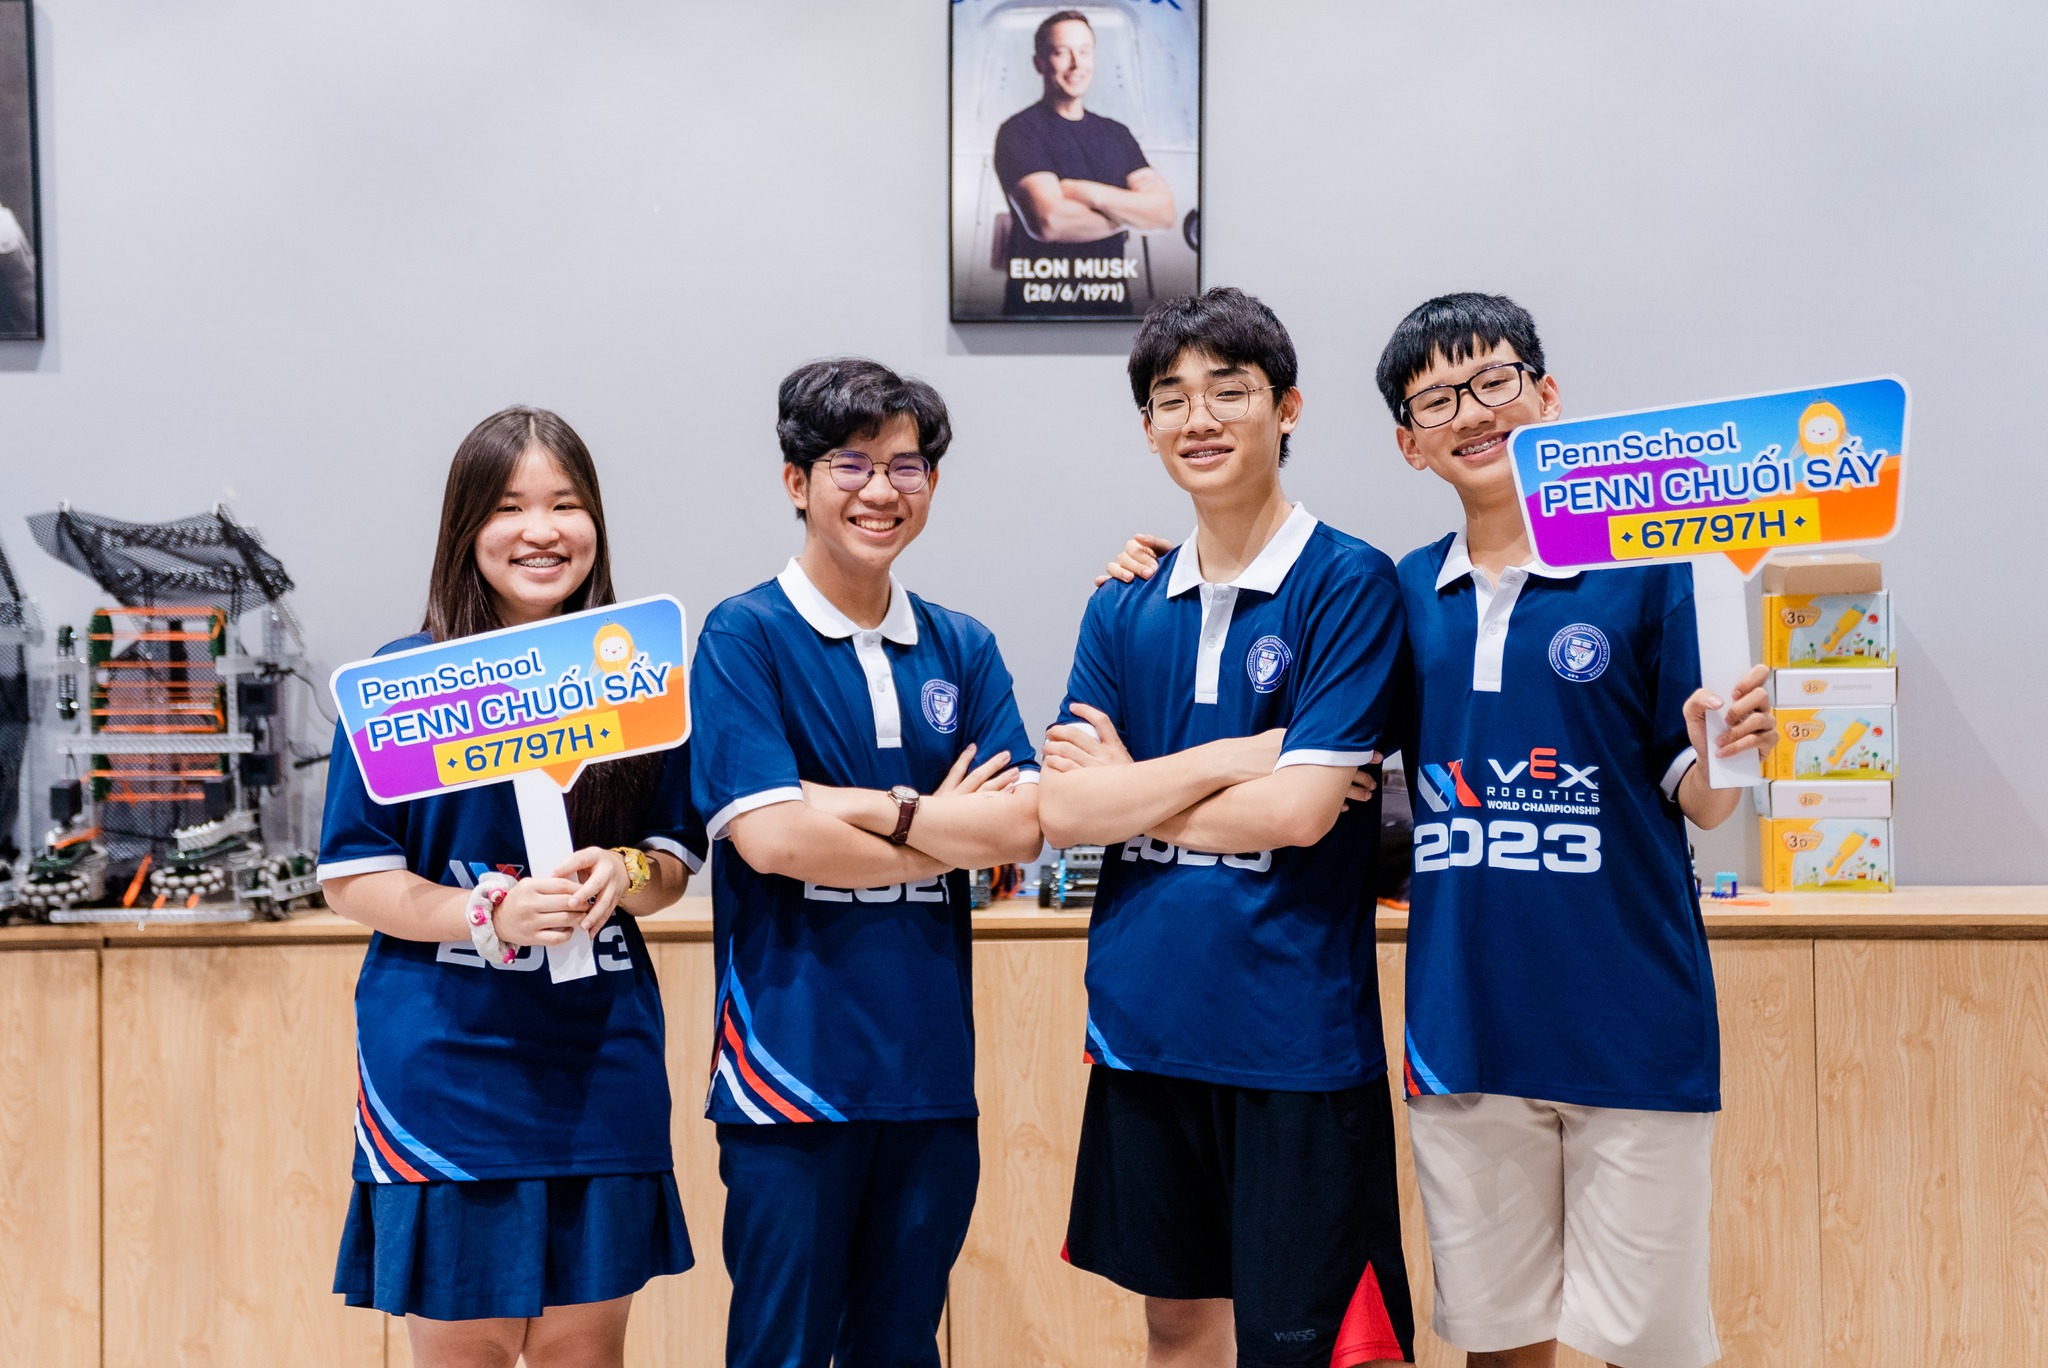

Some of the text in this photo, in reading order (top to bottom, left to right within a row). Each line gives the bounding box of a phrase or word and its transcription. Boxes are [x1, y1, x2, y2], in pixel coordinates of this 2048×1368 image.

[1009, 257, 1138, 279] ELON MUSK
[1023, 281, 1125, 303] (28/6/1971)
[1540, 425, 1737, 468] PennSchool
[1543, 439, 1884, 514] PENN CHUỐI SẤY
[1641, 509, 1786, 549] 67797H
[361, 651, 543, 705] PennSchool
[369, 655, 669, 748] PENN CHUỐI SẤY
[464, 724, 594, 772] 67797H
[1487, 747, 1599, 790] VEX
[1487, 786, 1600, 803] ROBOTICS
[1487, 800, 1601, 815] WORLD CHAMPIONSHIP
[1413, 817, 1602, 873] 2023
